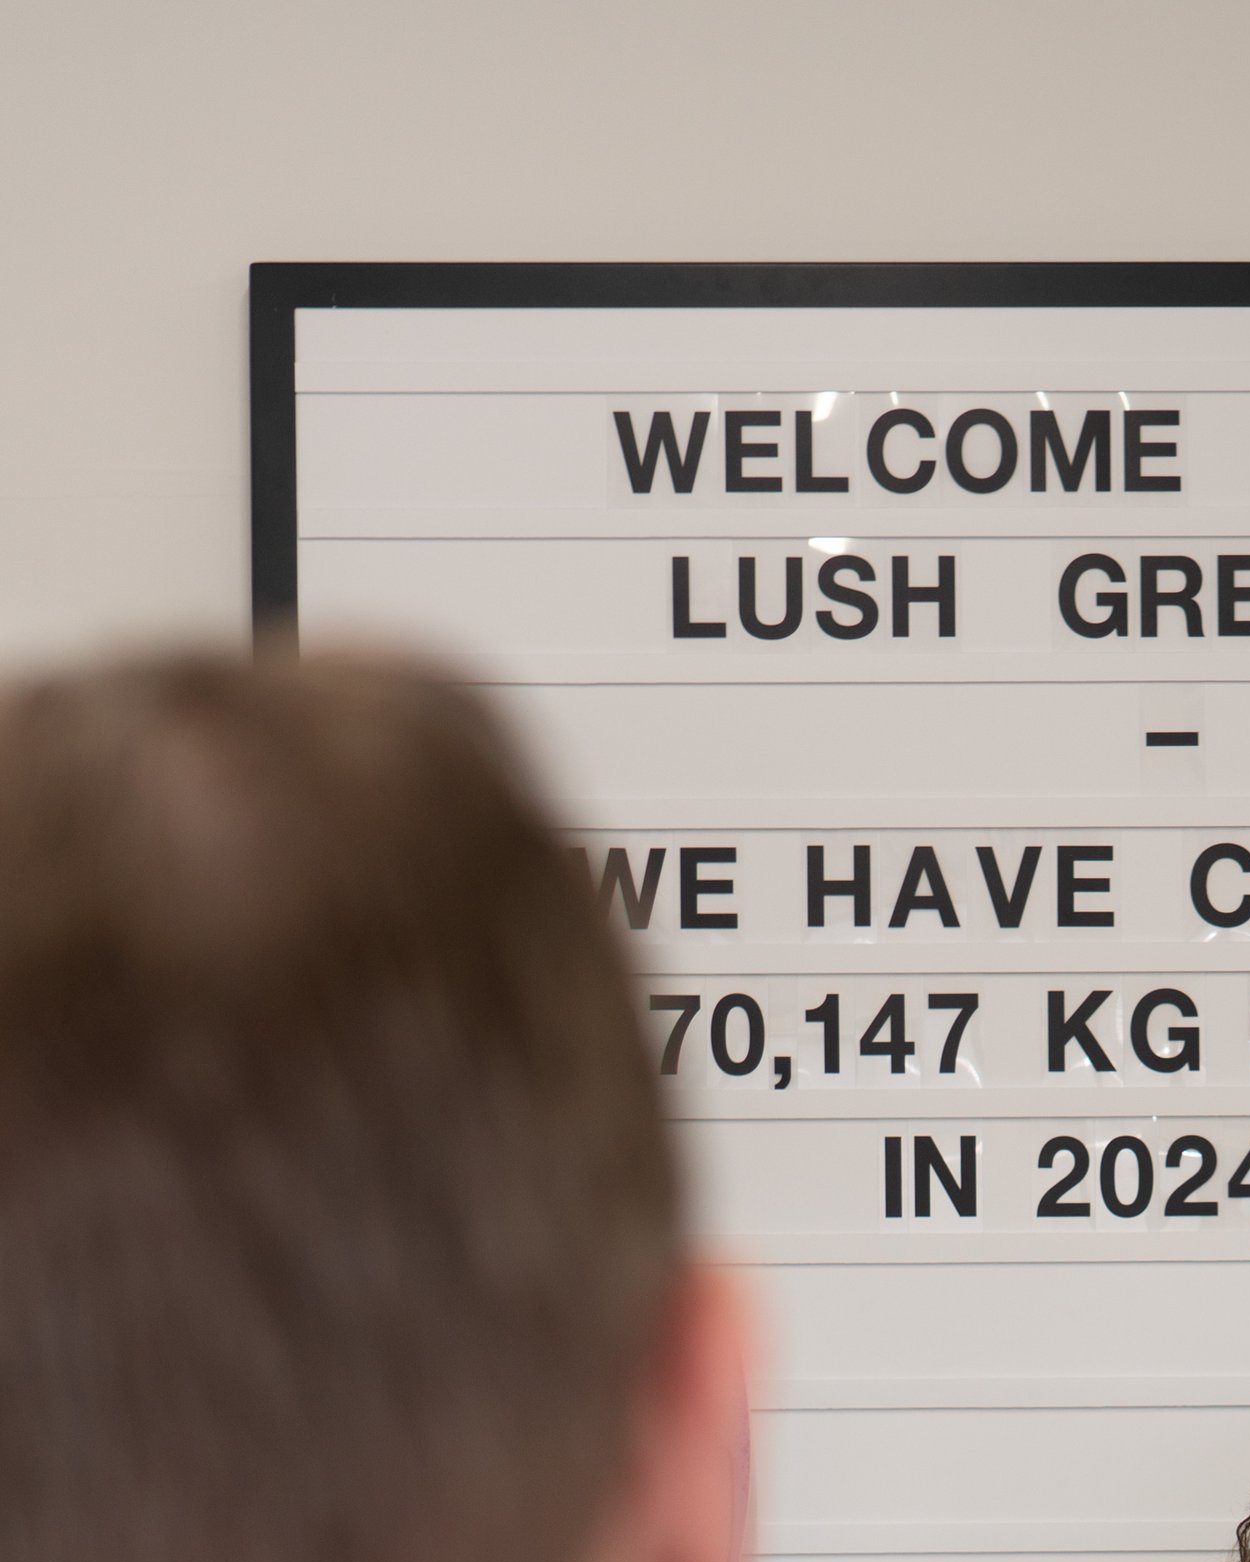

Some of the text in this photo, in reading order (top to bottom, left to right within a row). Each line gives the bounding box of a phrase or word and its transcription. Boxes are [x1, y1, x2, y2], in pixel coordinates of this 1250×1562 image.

[613, 408, 1182, 495] WELCOME
[672, 554, 956, 641] LUSH
[570, 846, 739, 930] WE
[806, 844, 1115, 929] HAVE
[650, 992, 979, 1090] 70,147
[1047, 987, 1200, 1074] KG
[884, 1135, 977, 1218] IN
